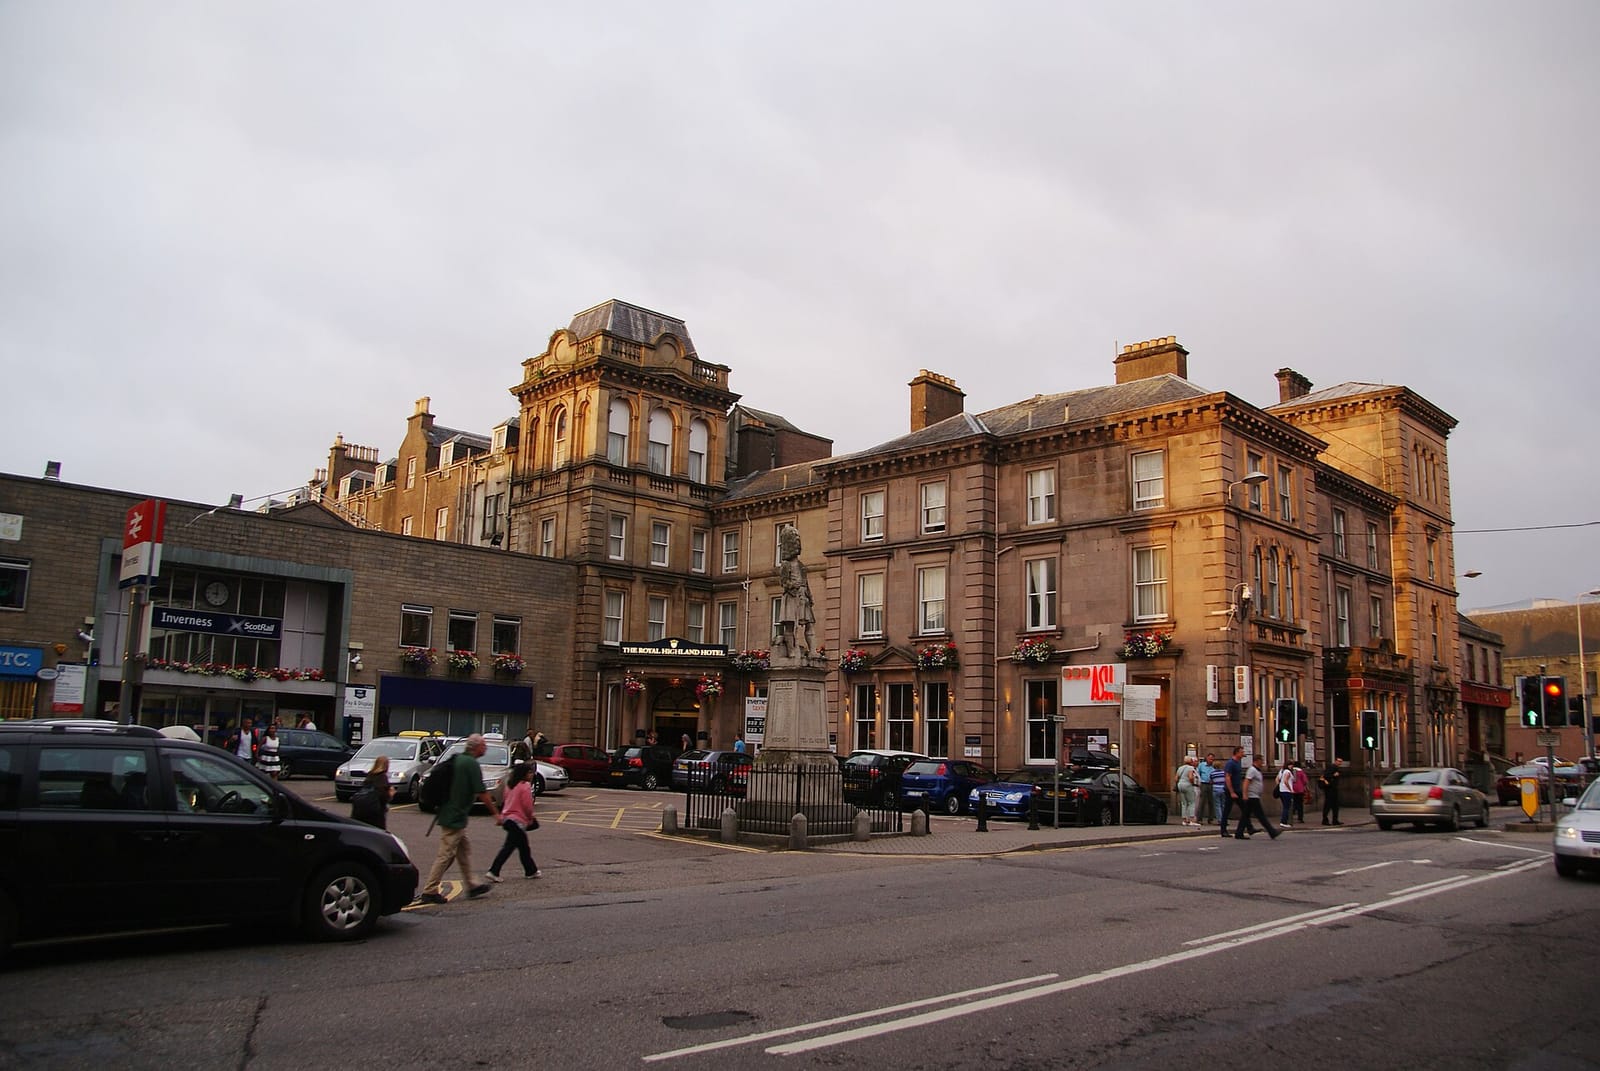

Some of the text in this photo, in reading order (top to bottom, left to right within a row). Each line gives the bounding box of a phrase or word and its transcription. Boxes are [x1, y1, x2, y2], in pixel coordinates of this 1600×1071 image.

[161, 612, 212, 627] Inverness
[244, 621, 275, 632] ScotRail
[638, 647, 661, 655] ROYAL
[661, 648, 700, 656] HIGHLAND
[0, 652, 32, 667] TC.
